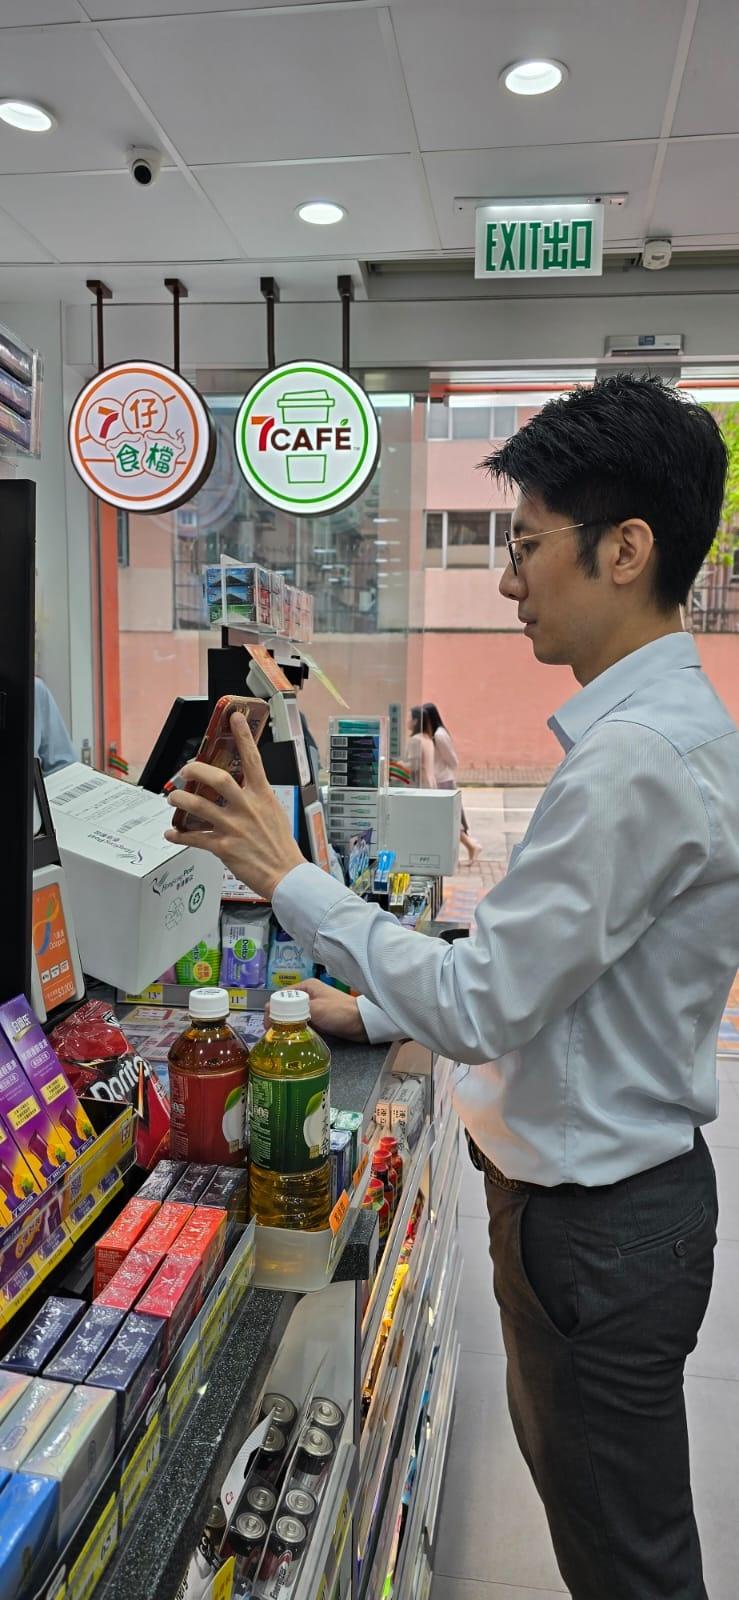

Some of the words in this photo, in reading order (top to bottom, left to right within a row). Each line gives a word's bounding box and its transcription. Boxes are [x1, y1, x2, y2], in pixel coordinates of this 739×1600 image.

[485, 221, 542, 272] EXIT
[543, 220, 593, 270] 出口
[116, 444, 174, 473] 食檔
[90, 1055, 152, 1102] Dorito
